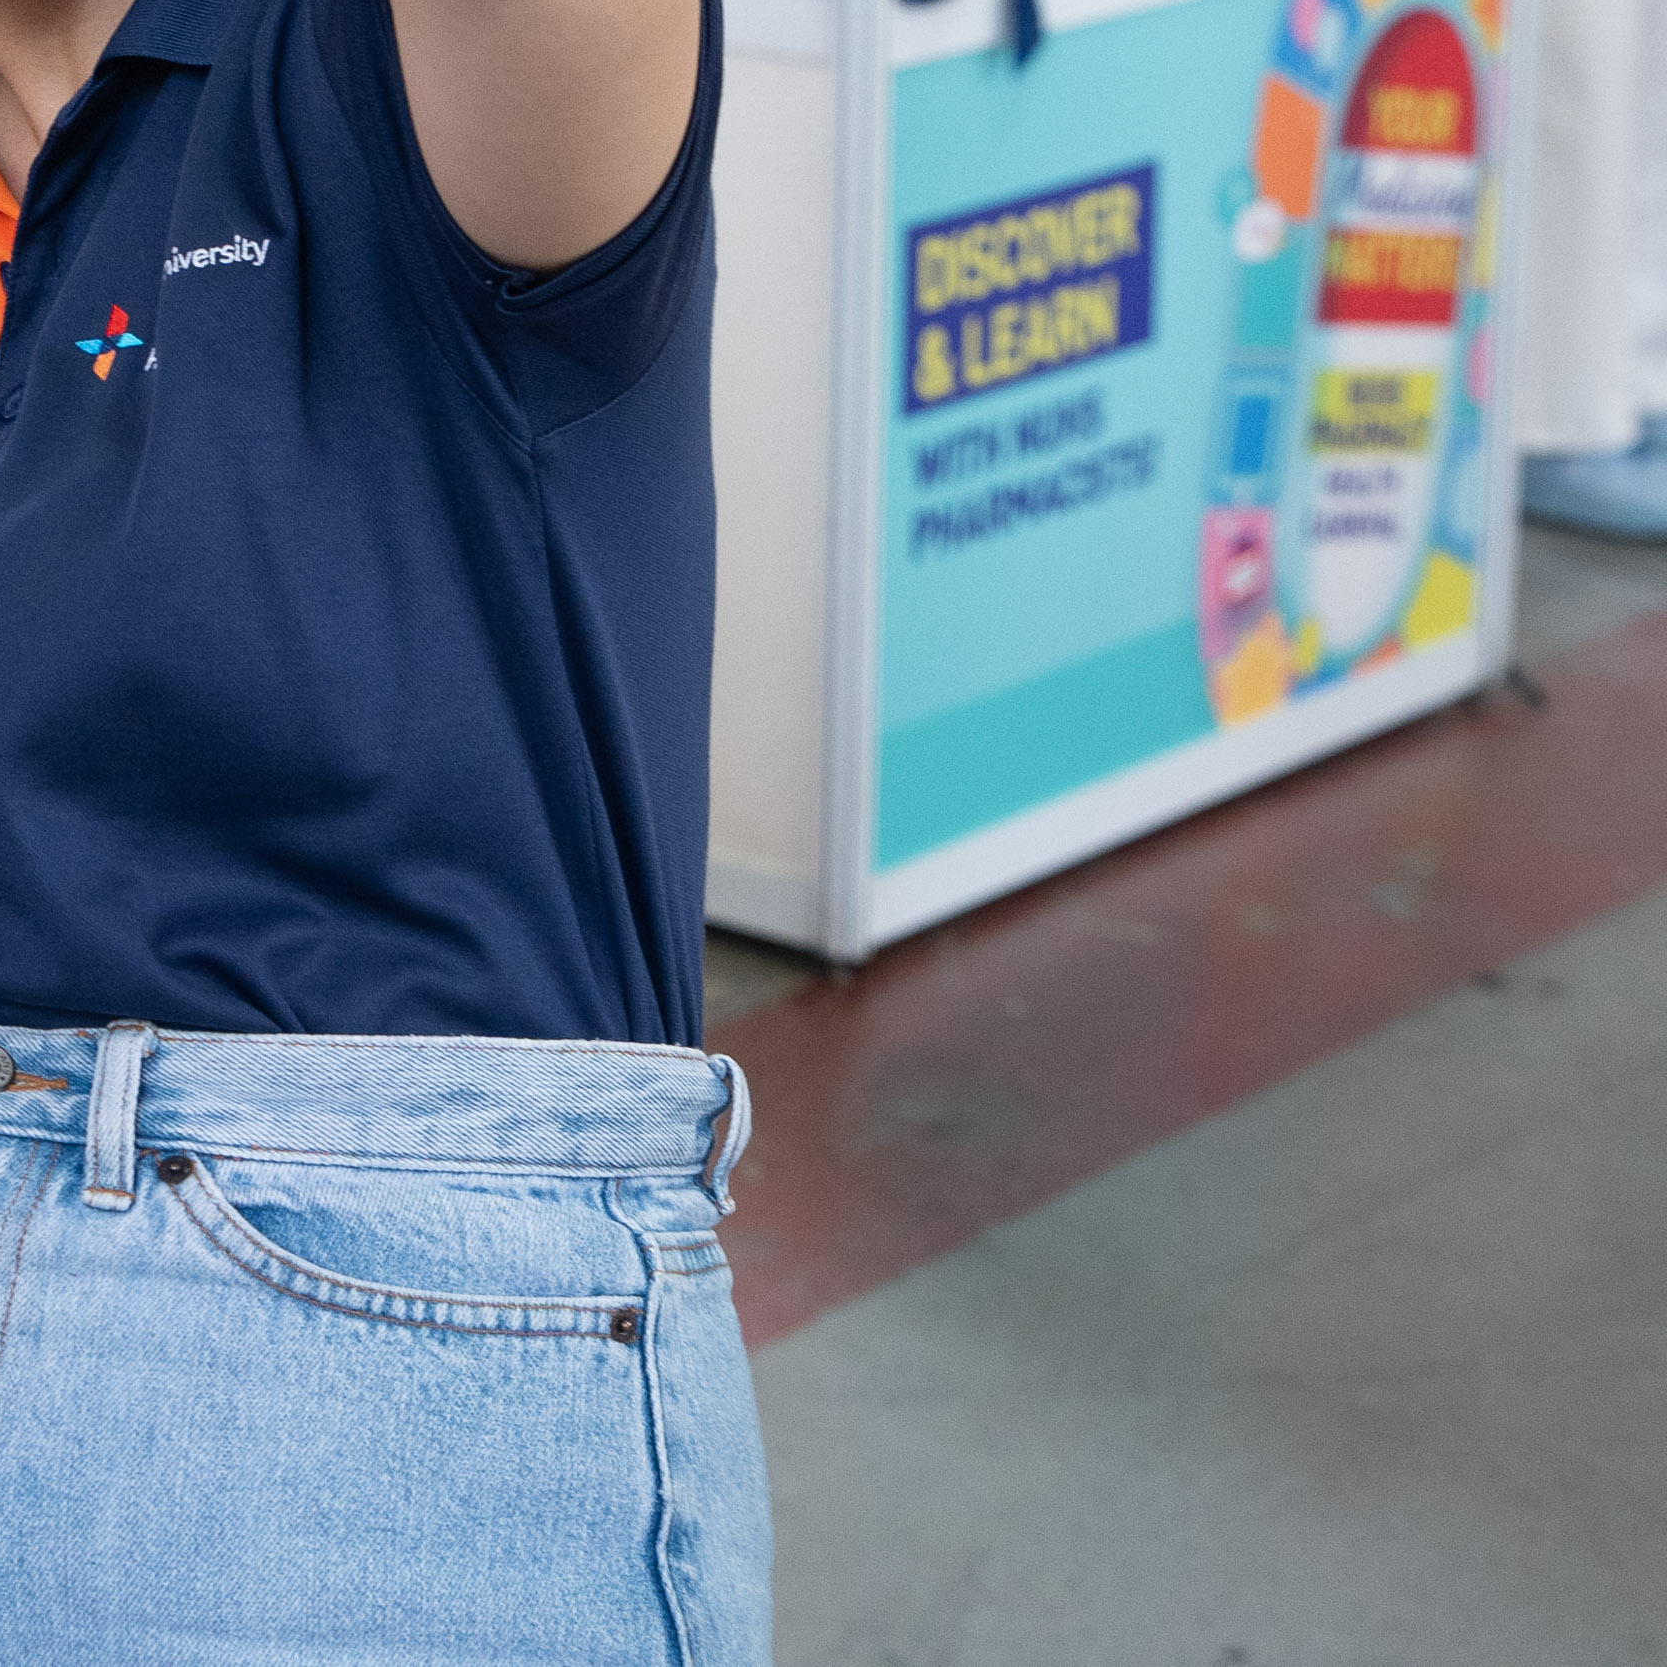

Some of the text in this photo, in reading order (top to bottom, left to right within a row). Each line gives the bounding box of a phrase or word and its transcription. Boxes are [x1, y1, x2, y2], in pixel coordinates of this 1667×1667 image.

[162, 234, 271, 276] niversity
[914, 182, 1142, 315] DISCOVER
[913, 275, 1122, 401] & LEARN
